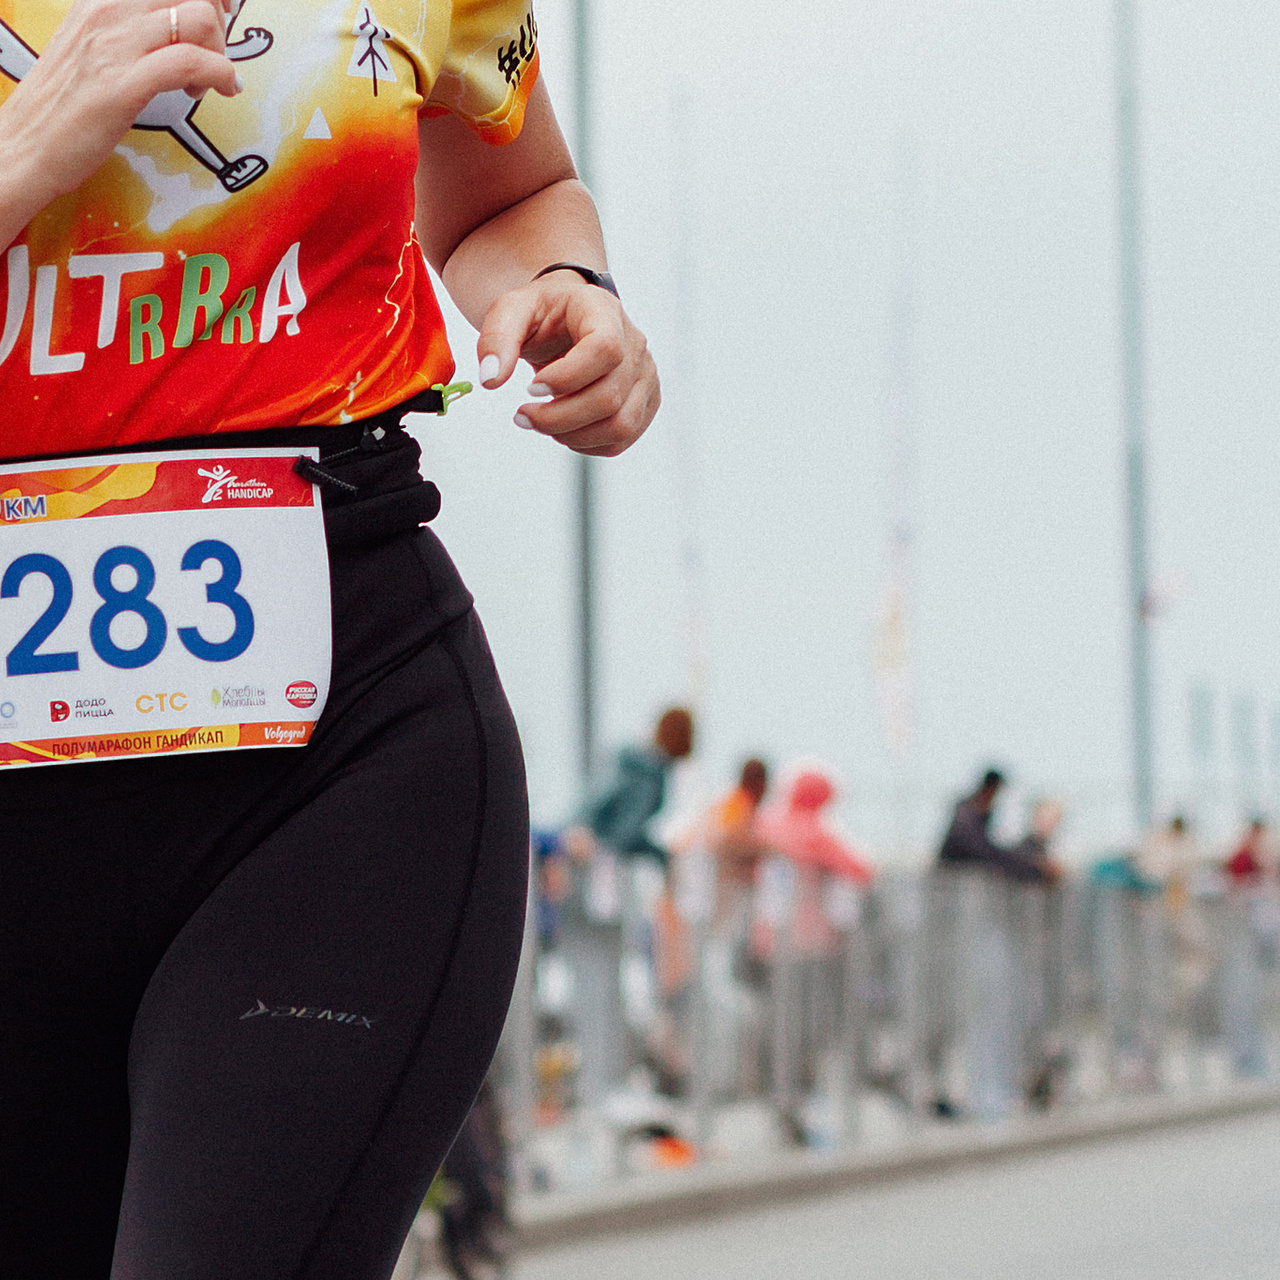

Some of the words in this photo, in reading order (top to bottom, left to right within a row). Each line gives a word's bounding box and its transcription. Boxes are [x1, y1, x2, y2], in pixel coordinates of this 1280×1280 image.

[227, 488, 274, 500] HANDICAP
[0, 538, 255, 677] 283
[75, 698, 106, 709] ДОДО
[75, 708, 115, 718] ПИЦЦА
[264, 725, 306, 743] Volgograd
[52, 736, 152, 757] ПОЛУМАРАФОН
[156, 730, 224, 750] ГАНДИКАП
